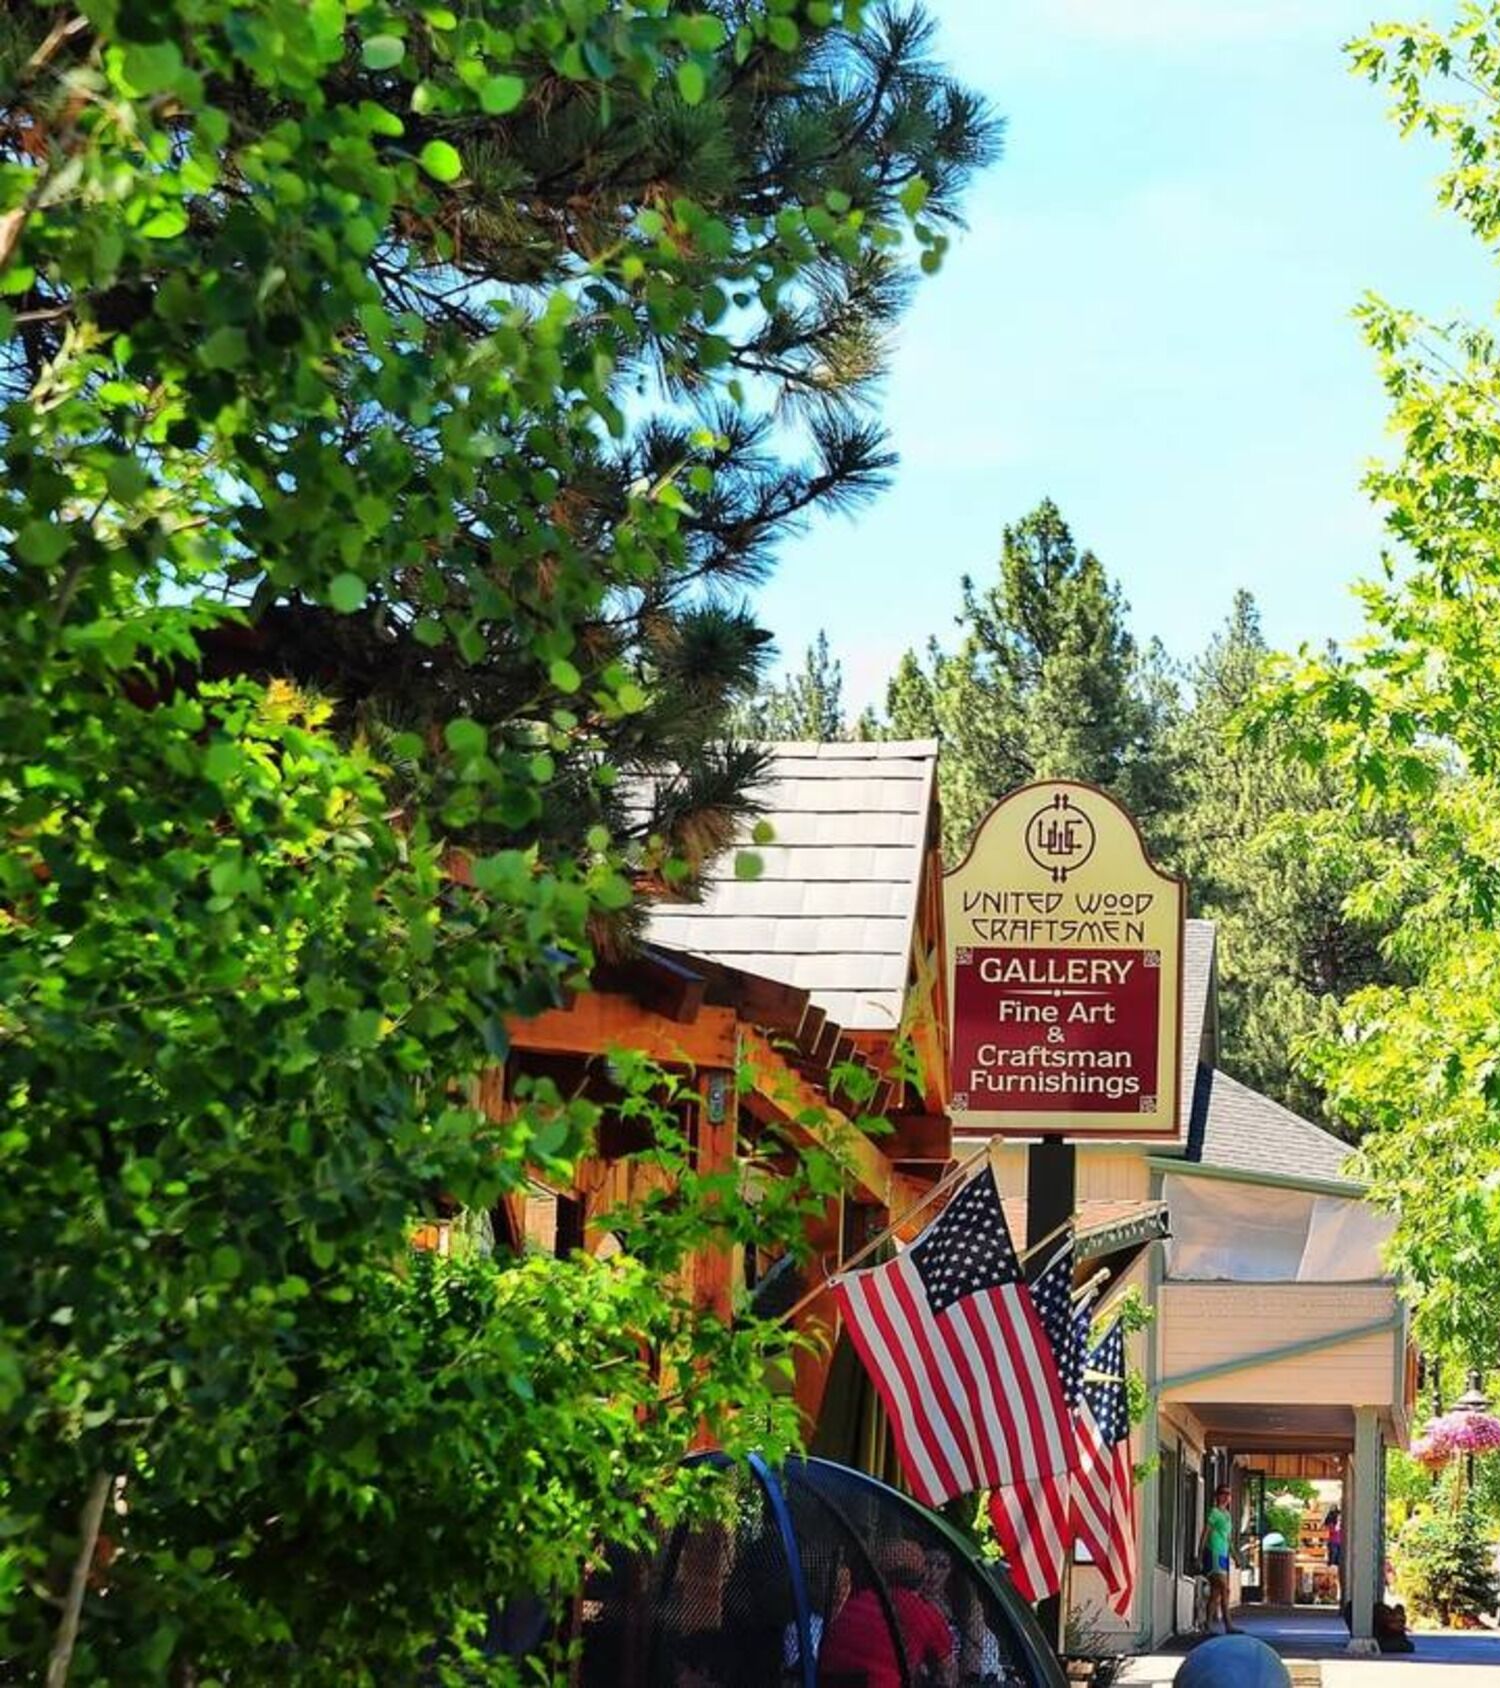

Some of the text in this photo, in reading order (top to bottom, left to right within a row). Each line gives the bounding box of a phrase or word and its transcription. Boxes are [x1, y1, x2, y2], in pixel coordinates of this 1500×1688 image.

[963, 891, 1154, 916] UNITED WOOD
[971, 918, 1145, 943] CRAFTSMEN
[979, 957, 1134, 984] GALLERY
[999, 1000, 1116, 1024] Fine Art
[1046, 1025, 1066, 1043] &
[977, 1044, 1132, 1069] Craftsman
[970, 1069, 1141, 1100] Furnishings
